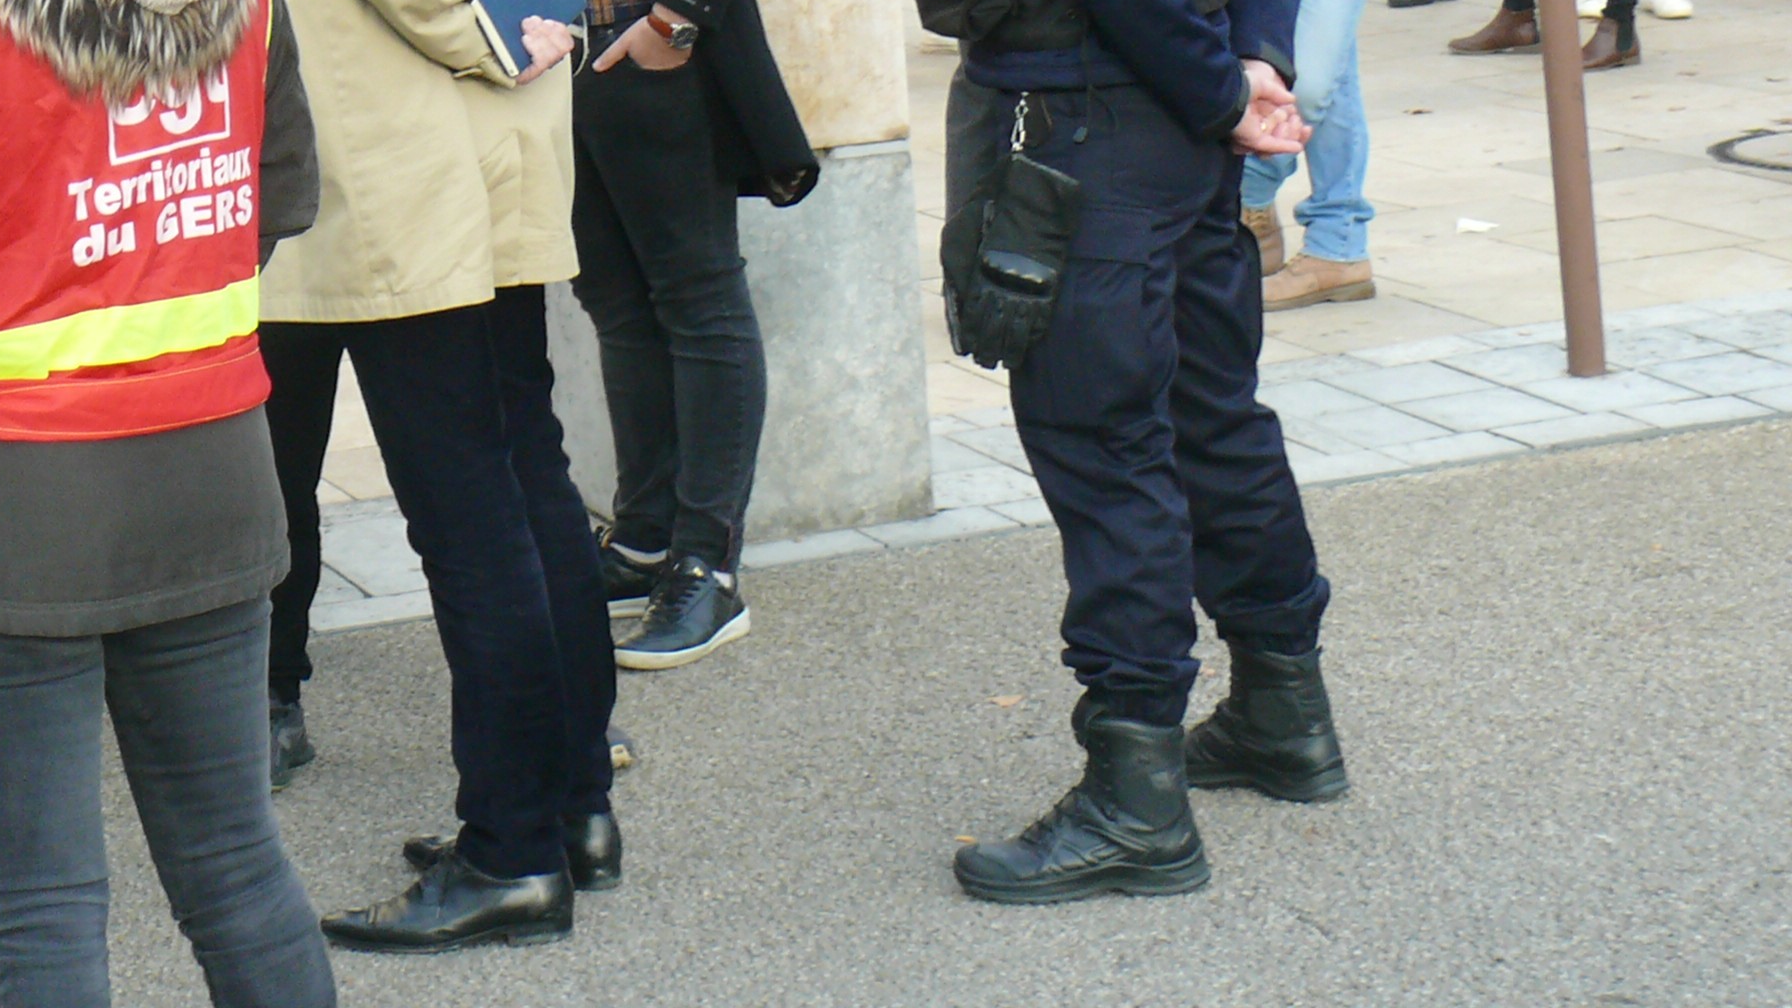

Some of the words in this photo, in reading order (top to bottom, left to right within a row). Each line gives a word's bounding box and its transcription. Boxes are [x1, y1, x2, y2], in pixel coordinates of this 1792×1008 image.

[67, 147, 252, 222] Territoriaux
[72, 221, 136, 268] du
[156, 183, 254, 246] GERS
